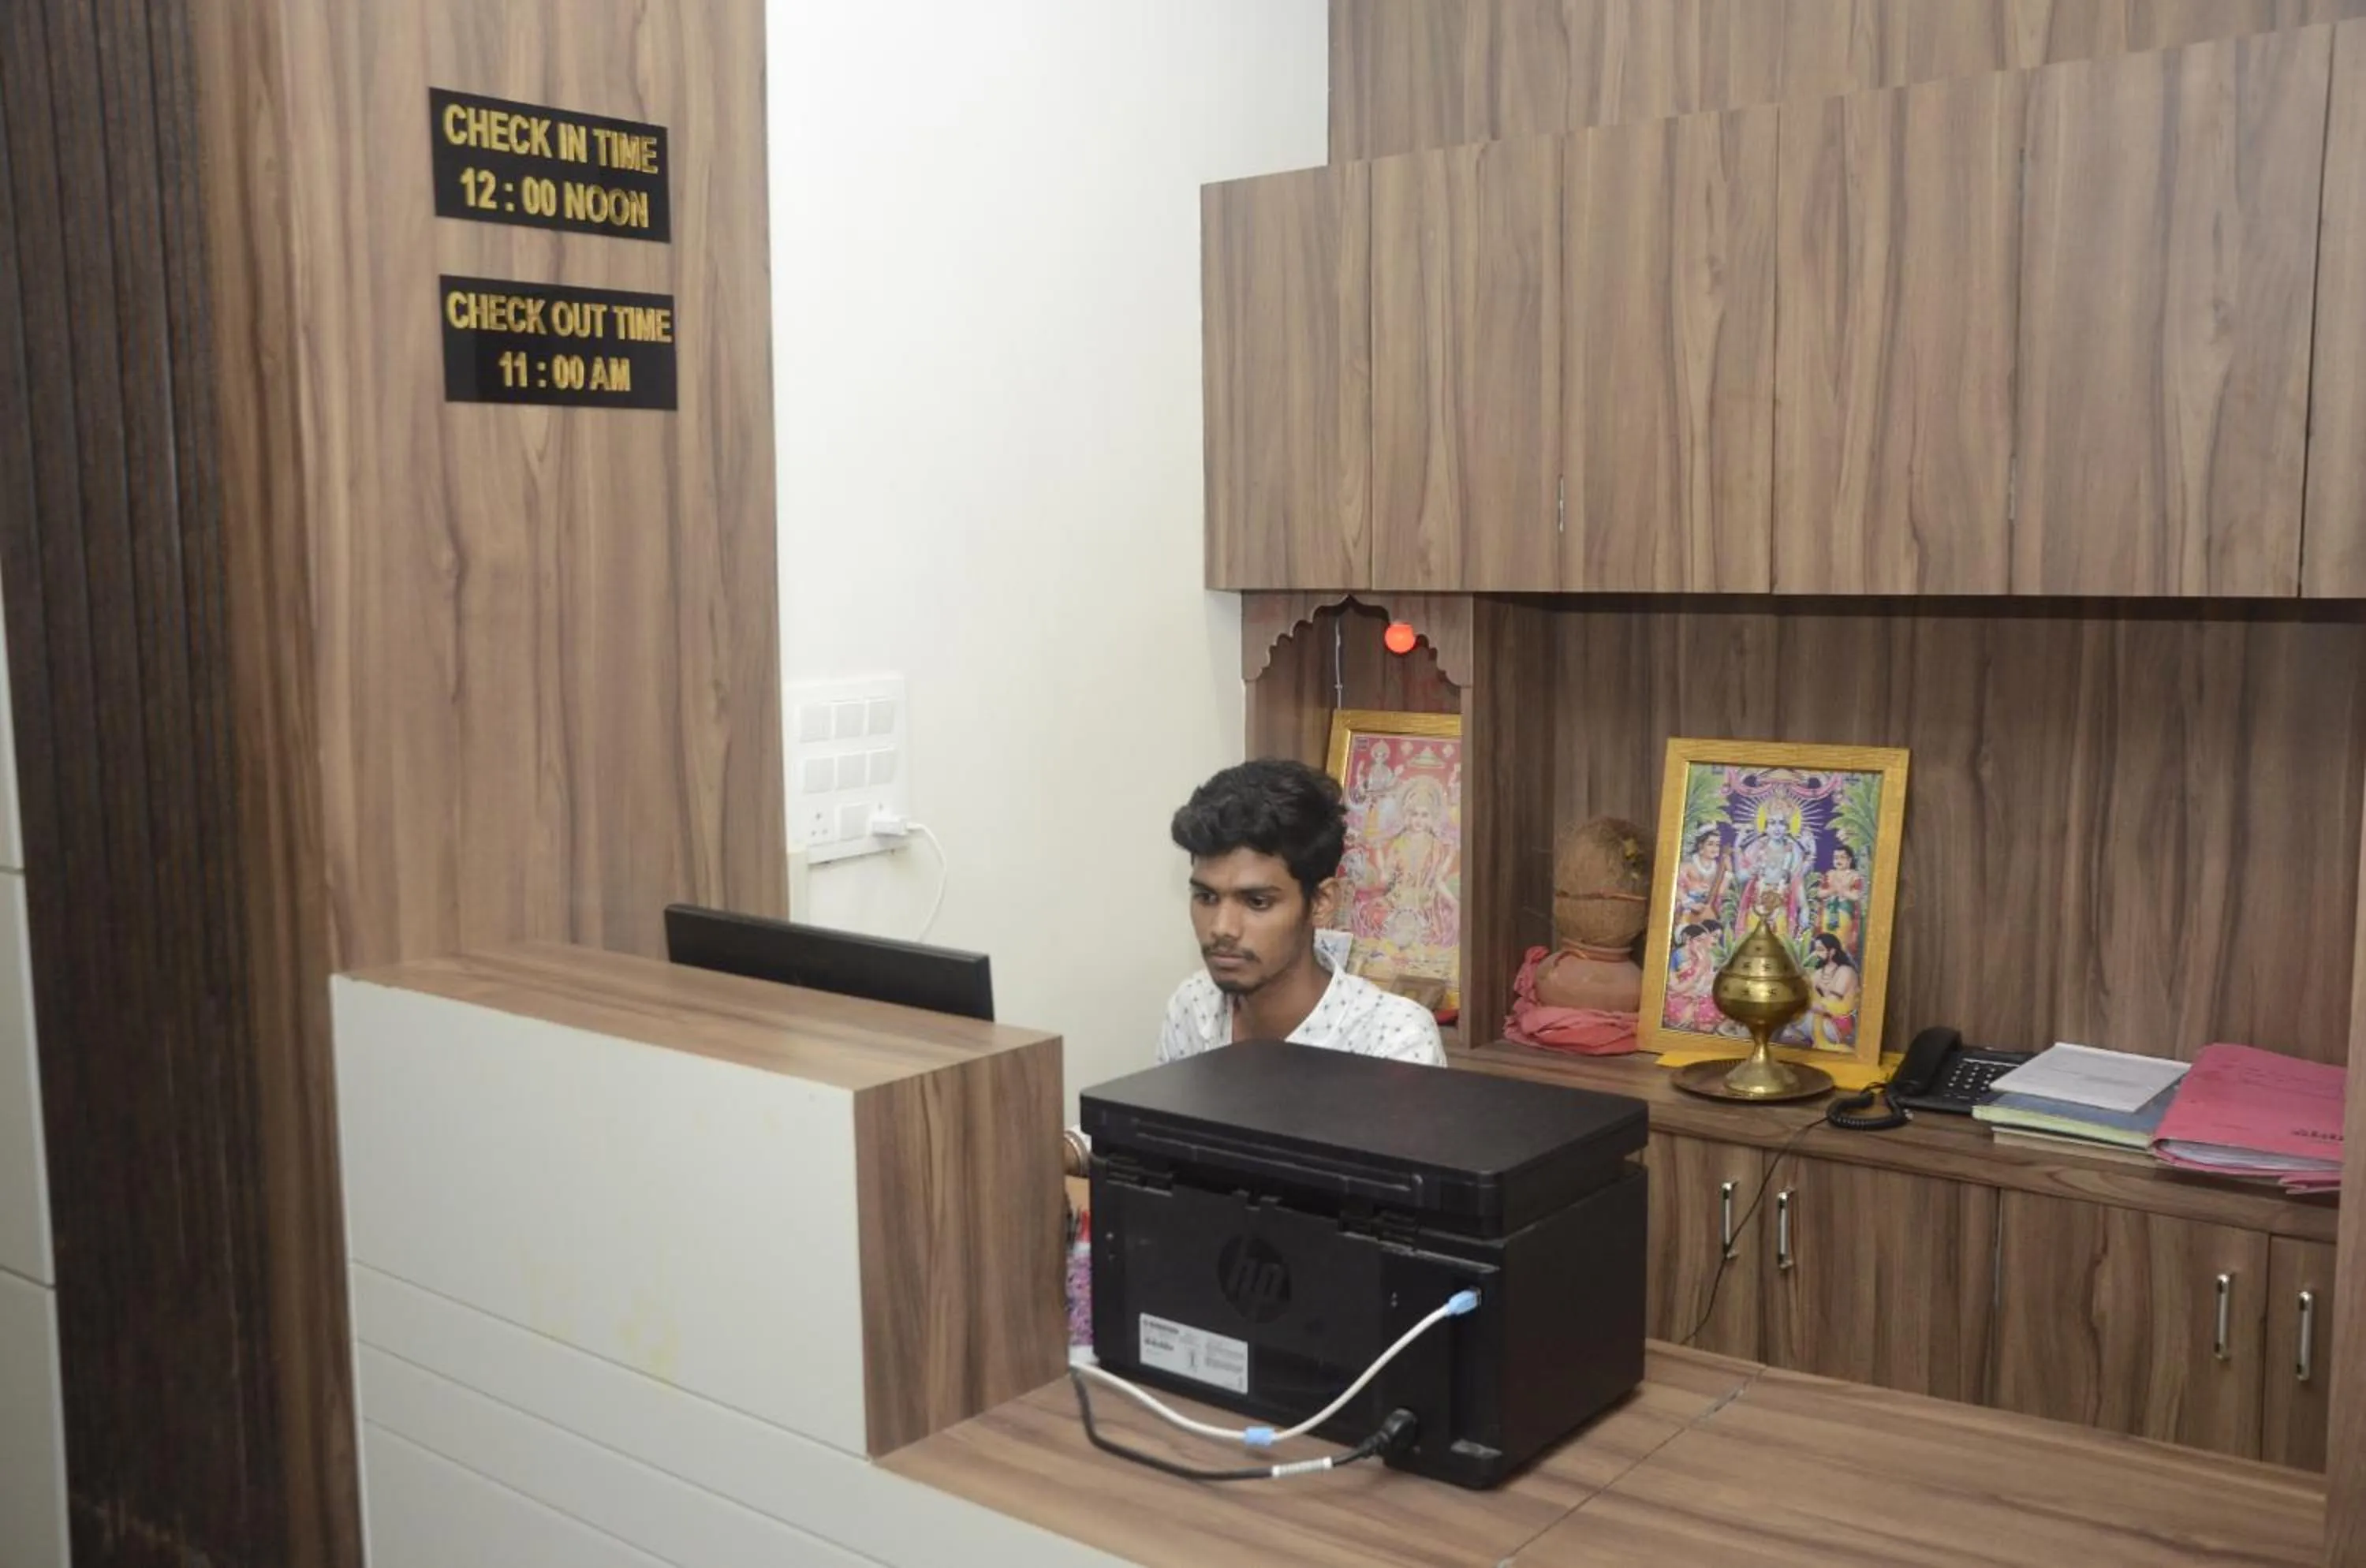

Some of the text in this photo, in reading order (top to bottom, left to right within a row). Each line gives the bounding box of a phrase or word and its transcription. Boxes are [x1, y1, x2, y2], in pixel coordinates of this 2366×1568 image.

[443, 103, 659, 174] CHECK IN TIME
[563, 181, 650, 228] NOON
[446, 290, 673, 342] CHECK OUT TIME
[589, 357, 631, 392] AM
[1224, 1235, 1286, 1323] hp
